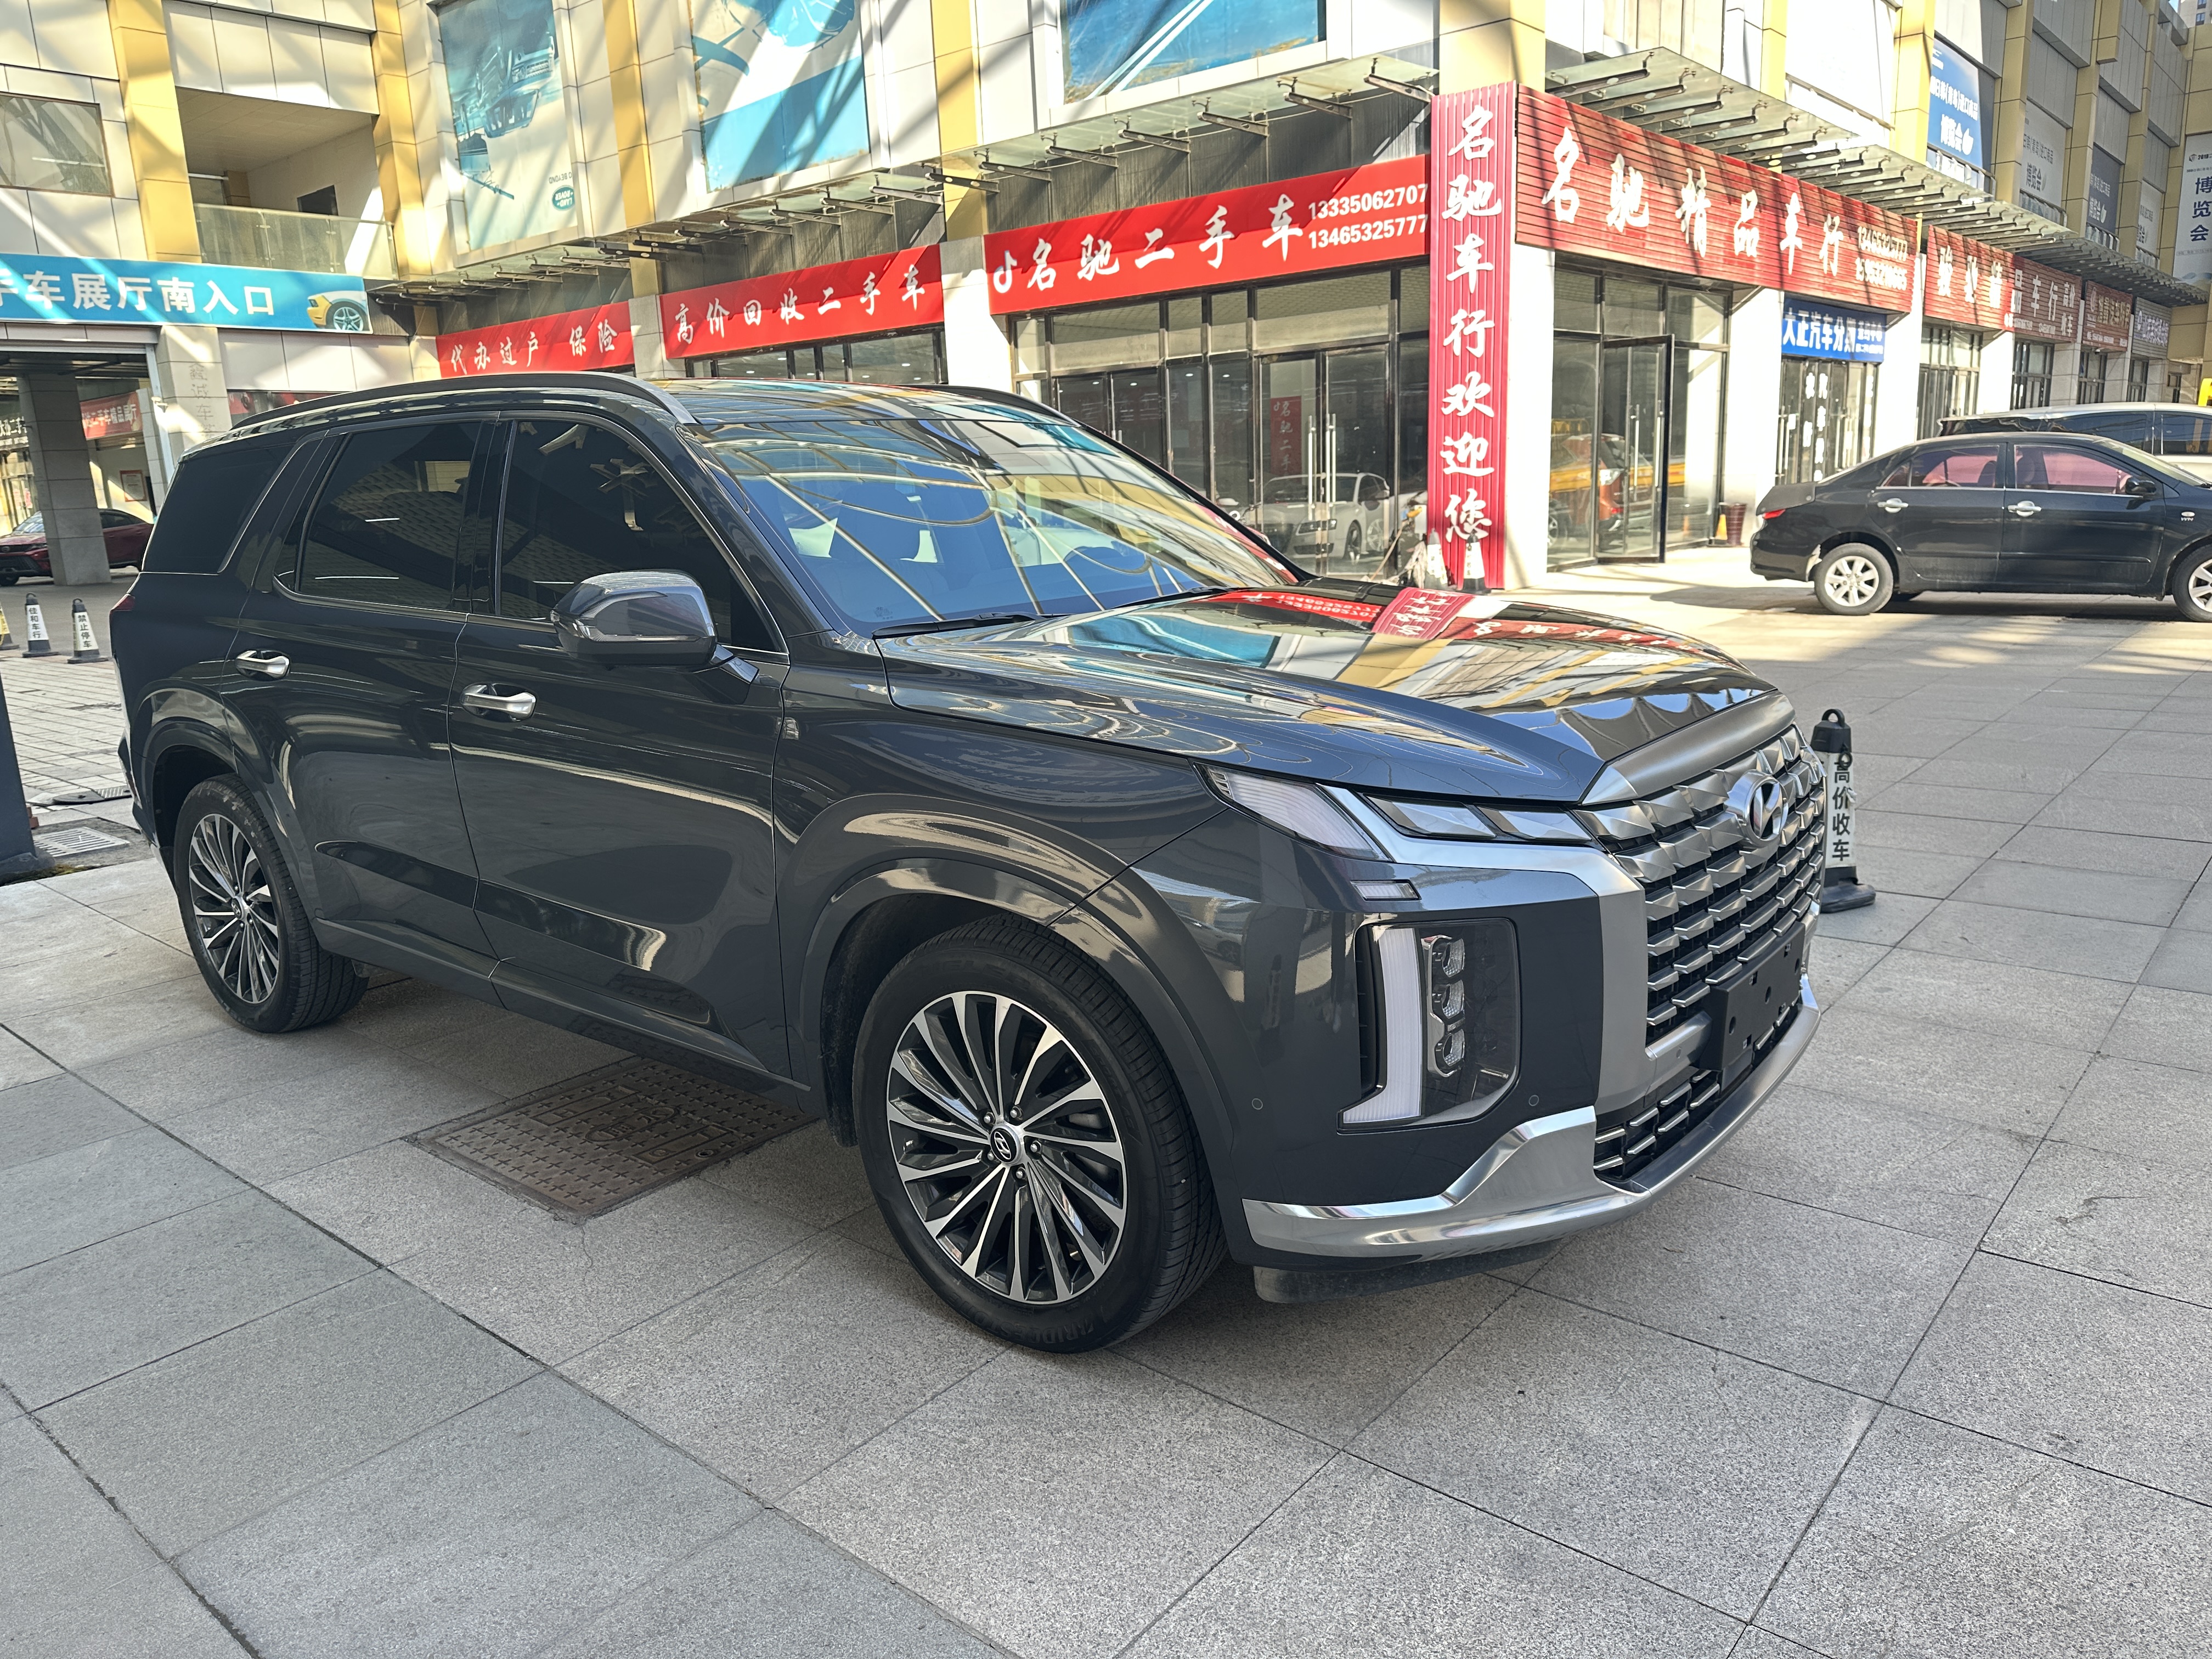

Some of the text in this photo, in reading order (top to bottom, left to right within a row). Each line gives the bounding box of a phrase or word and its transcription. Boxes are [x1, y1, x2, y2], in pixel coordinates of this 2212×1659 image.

[549, 173, 567, 184] BEYOND
[1308, 184, 1427, 219] 13335062707
[1542, 126, 1843, 276] 名驰精品车行
[1308, 214, 1427, 249] 13465325777
[2190, 177, 2212, 242] 博览会
[1027, 193, 1303, 291] 名驰二手车
[1858, 226, 1908, 261] 13465325777
[675, 264, 925, 345] 高价回收二手车
[1441, 104, 1502, 543] 名驰车行欢迎您
[451, 319, 617, 375] 代办过户 保险
[1279, 401, 1294, 476] 名驰二手
[29, 607, 41, 639] 佳和车行
[78, 615, 92, 648] 禁止停车
[1832, 760, 1851, 861] 高价收车
[595, 1108, 673, 1137] 雨水
